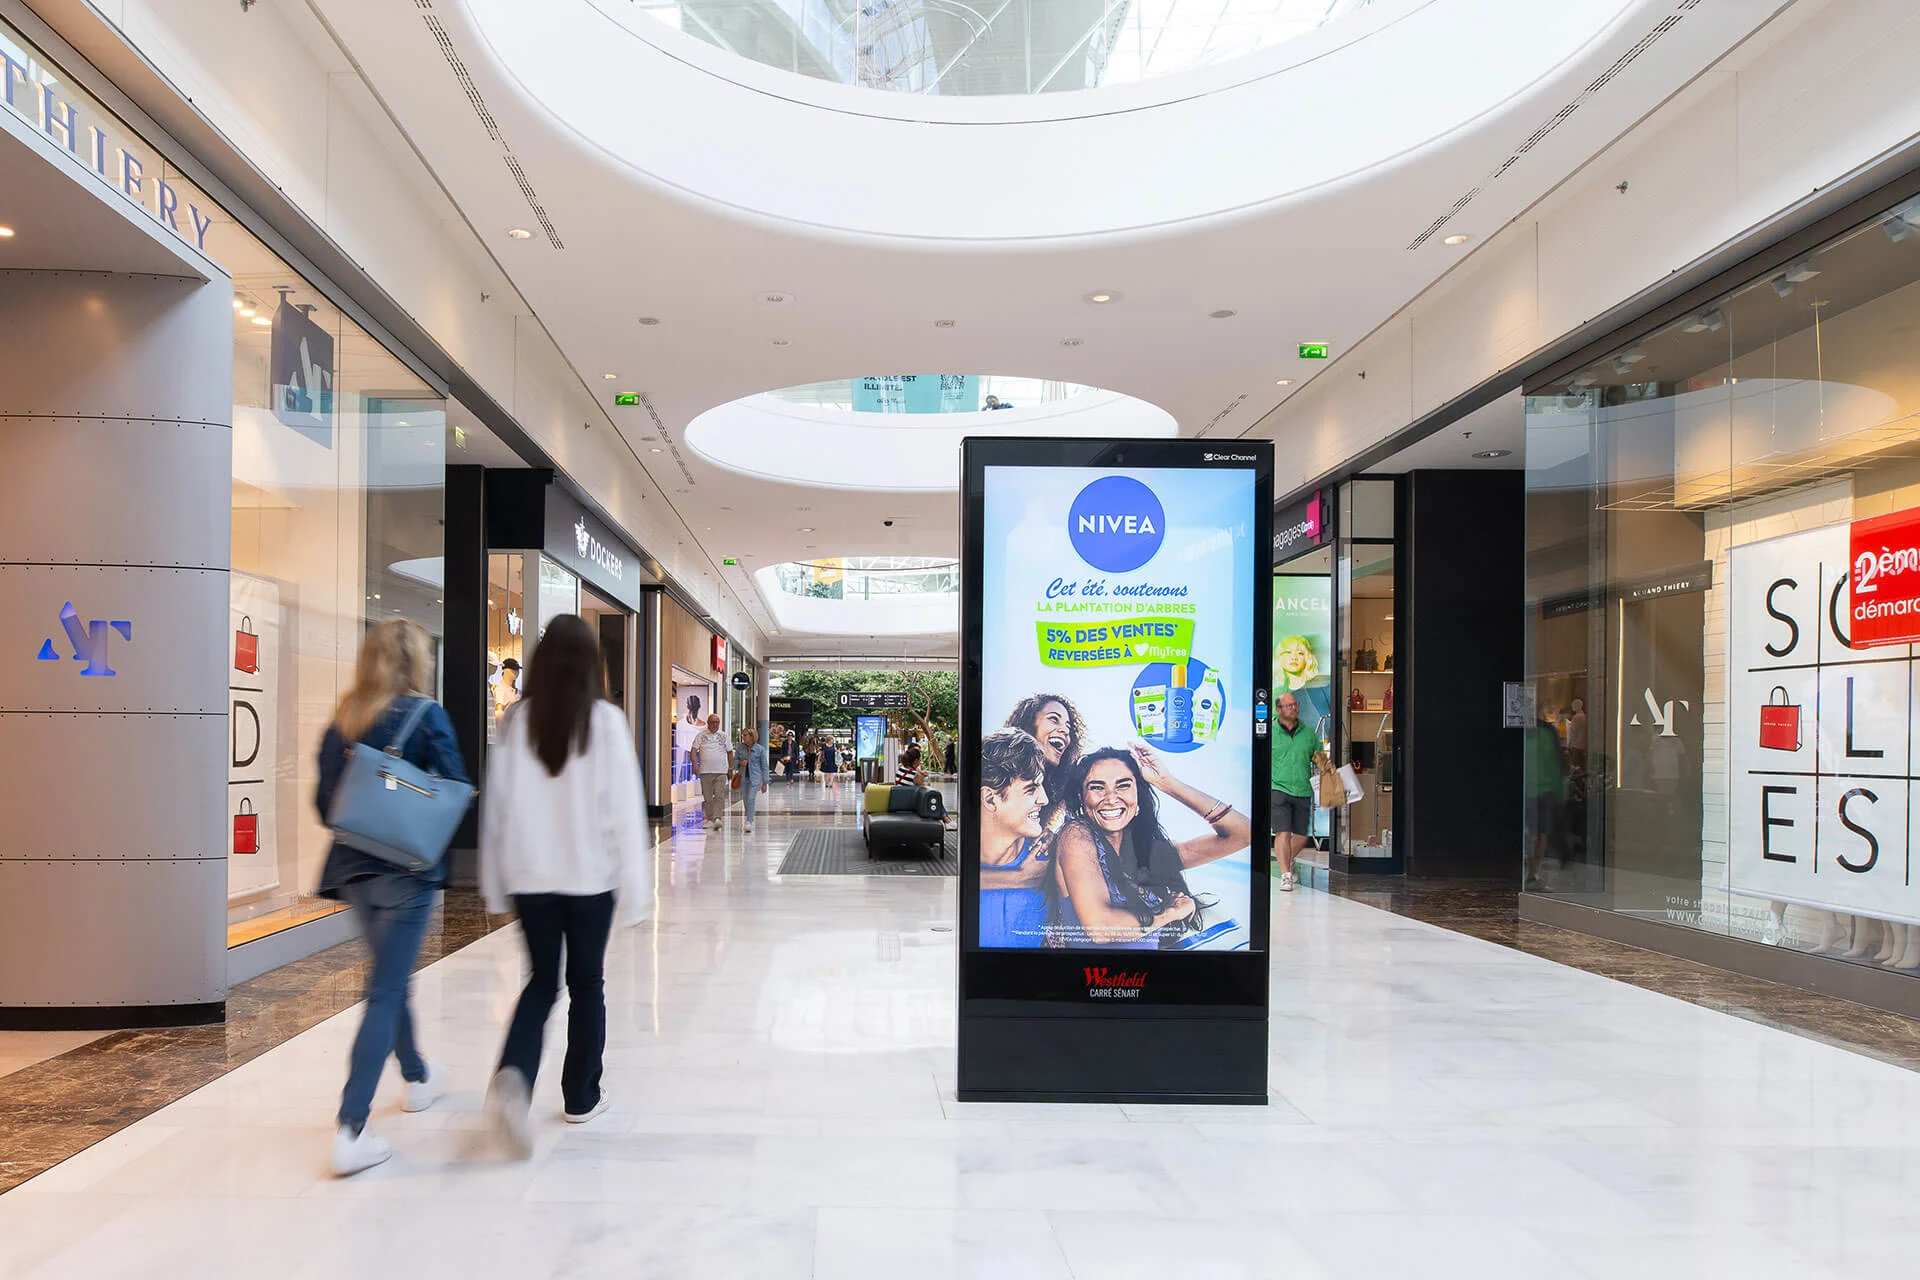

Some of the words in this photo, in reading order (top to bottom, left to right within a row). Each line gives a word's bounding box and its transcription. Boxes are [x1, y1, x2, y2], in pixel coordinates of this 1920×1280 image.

[0, 50, 212, 250] THIERY
[1213, 453, 1230, 461] Clear
[1078, 515, 1156, 534] NIVEA
[590, 535, 623, 581] DOCKERS
[1045, 577, 1077, 599] Cet
[1113, 582, 1190, 597] soutenons
[1663, 581, 1690, 592] THIERY
[1037, 601, 1053, 612] LA
[1056, 602, 1133, 613] PLANTATION
[1136, 603, 1197, 614] D'ARBRES
[1275, 597, 1329, 611] ANCEL
[1046, 628, 1072, 644] 5%
[1076, 628, 1108, 643] DES
[1048, 646, 1121, 661] REVERSÉES
[1124, 643, 1132, 658] À
[1083, 967, 1149, 987] Westfield
[1089, 987, 1112, 998] CARRÉ
[1113, 987, 1140, 998] SÉNART
